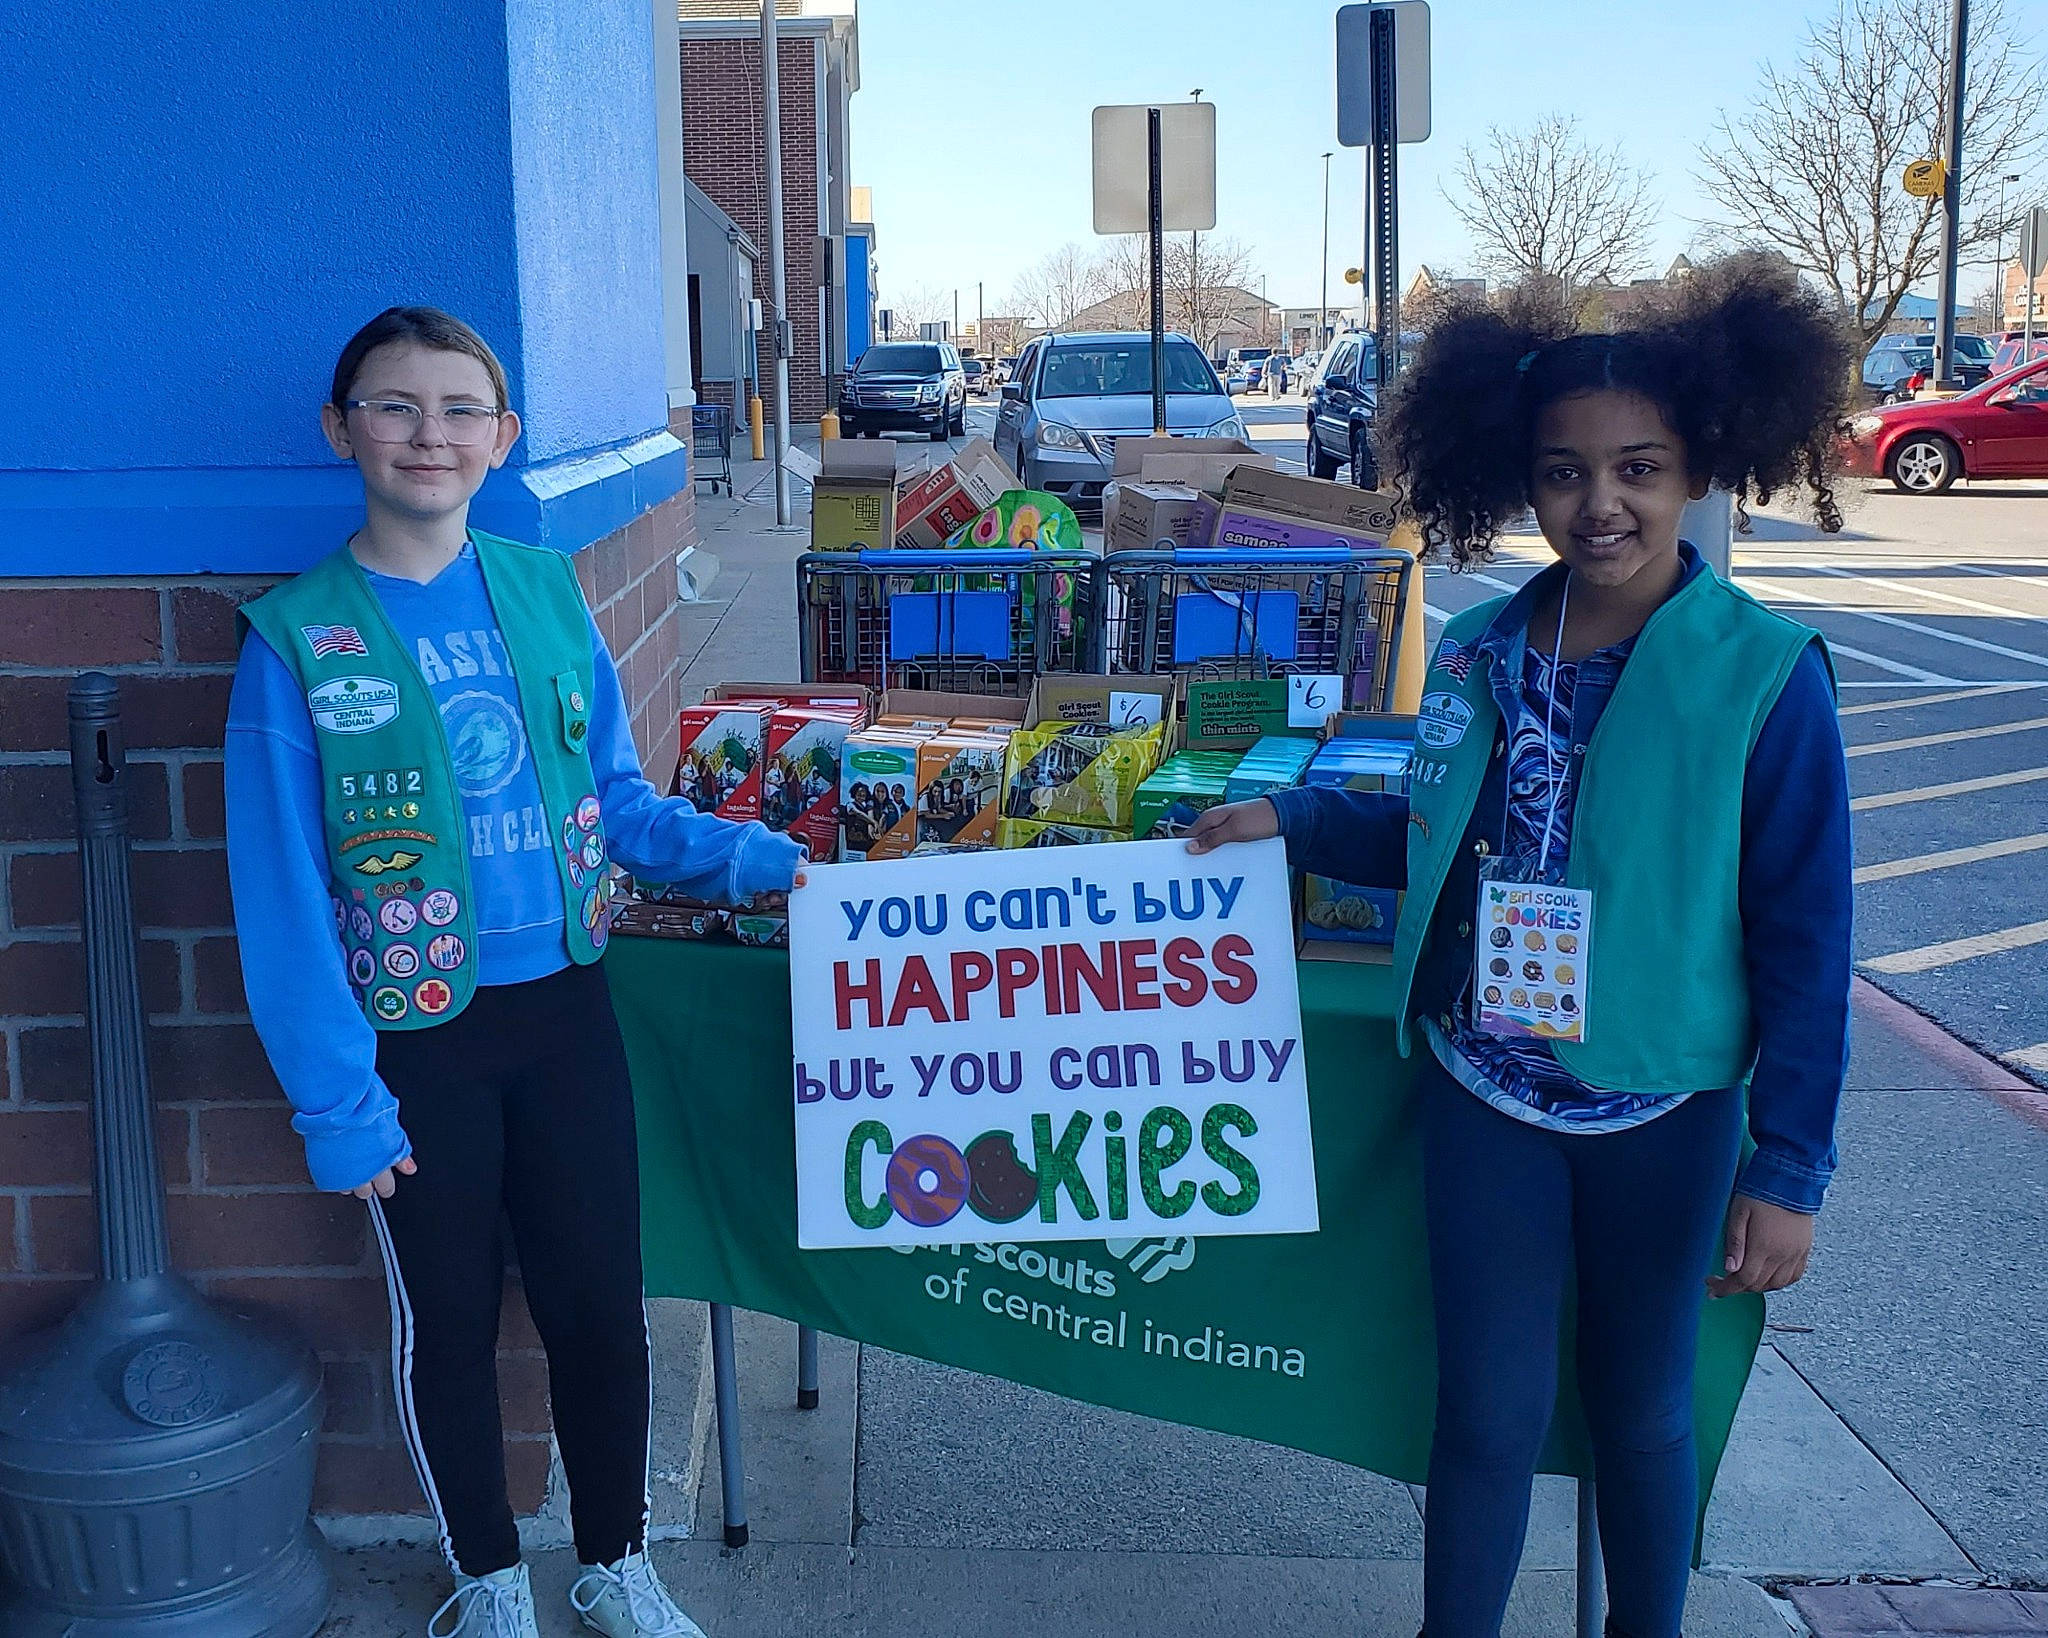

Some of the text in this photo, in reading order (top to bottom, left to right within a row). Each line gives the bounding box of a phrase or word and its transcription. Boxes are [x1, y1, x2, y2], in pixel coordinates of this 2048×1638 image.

[312, 689, 394, 705] GIRL SCOUTS USA
[1200, 692, 1215, 700] The
[333, 709, 375, 720] CENTRAL
[1058, 702, 1101, 711] Girl Scout
[336, 717, 376, 728] INDIANA
[1202, 722, 1260, 735] thin mints
[342, 771, 422, 798] 5482
[1509, 890, 1579, 908] girl scout
[833, 934, 1258, 1030] HAPPINESS
[975, 1242, 1117, 1297] scouts
[924, 1268, 1306, 1378] of central indiana
